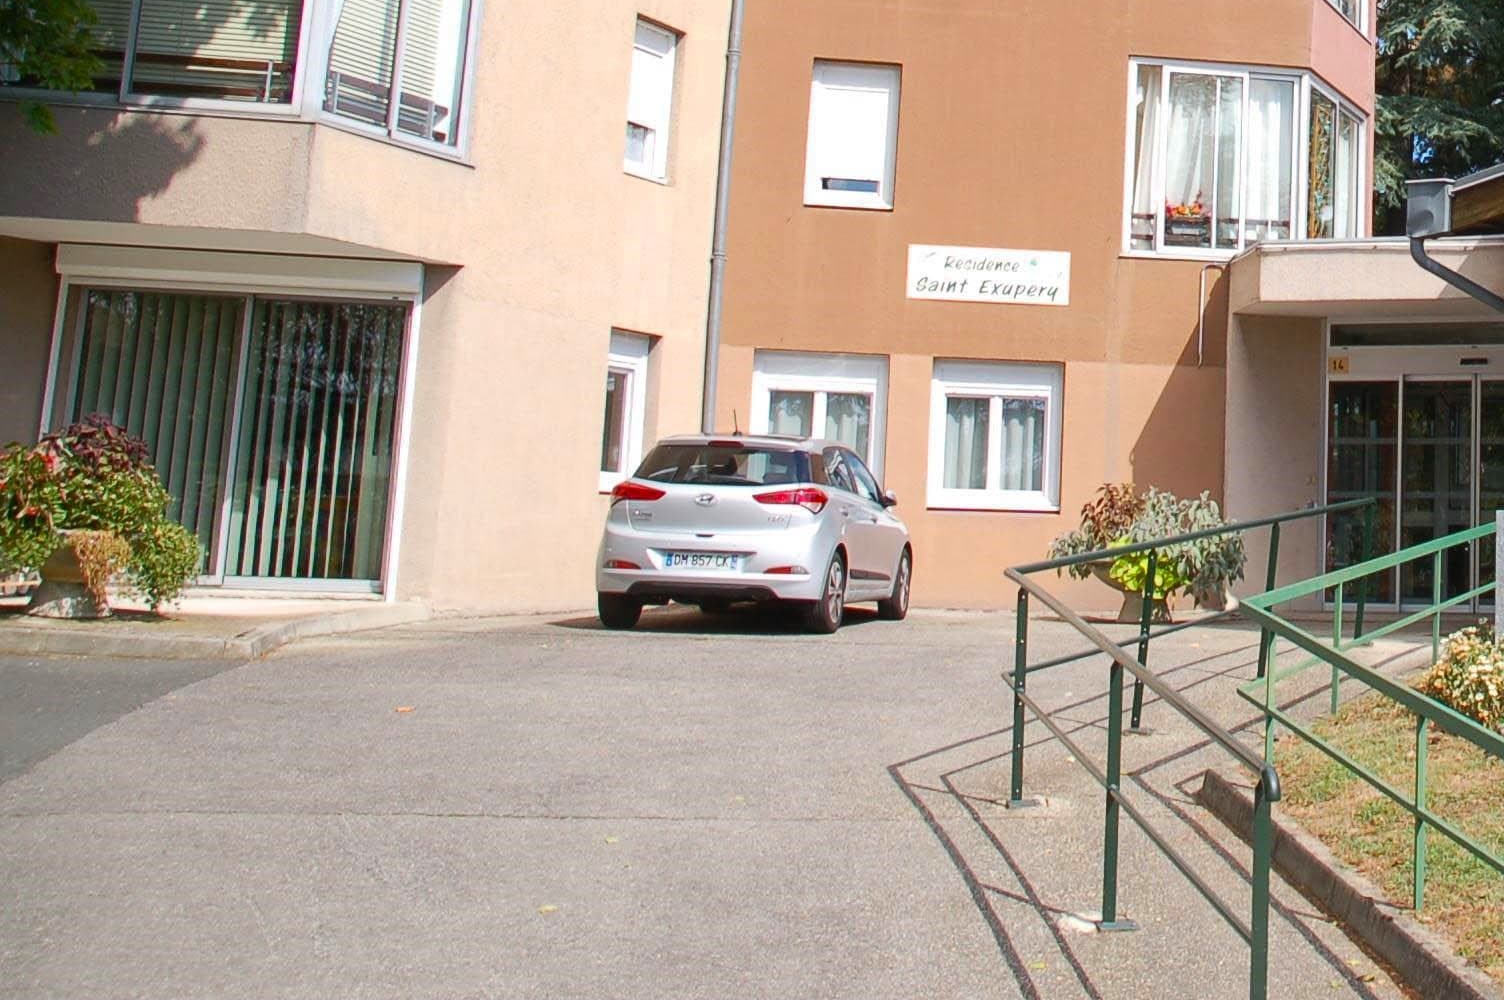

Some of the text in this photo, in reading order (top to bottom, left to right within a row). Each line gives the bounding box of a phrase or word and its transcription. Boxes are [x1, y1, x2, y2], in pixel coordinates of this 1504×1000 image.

[943, 255, 1021, 272] Residence
[915, 276, 1059, 302] Saint Exupery
[1333, 359, 1345, 370] 14
[674, 553, 730, 568] DM 857 CK
